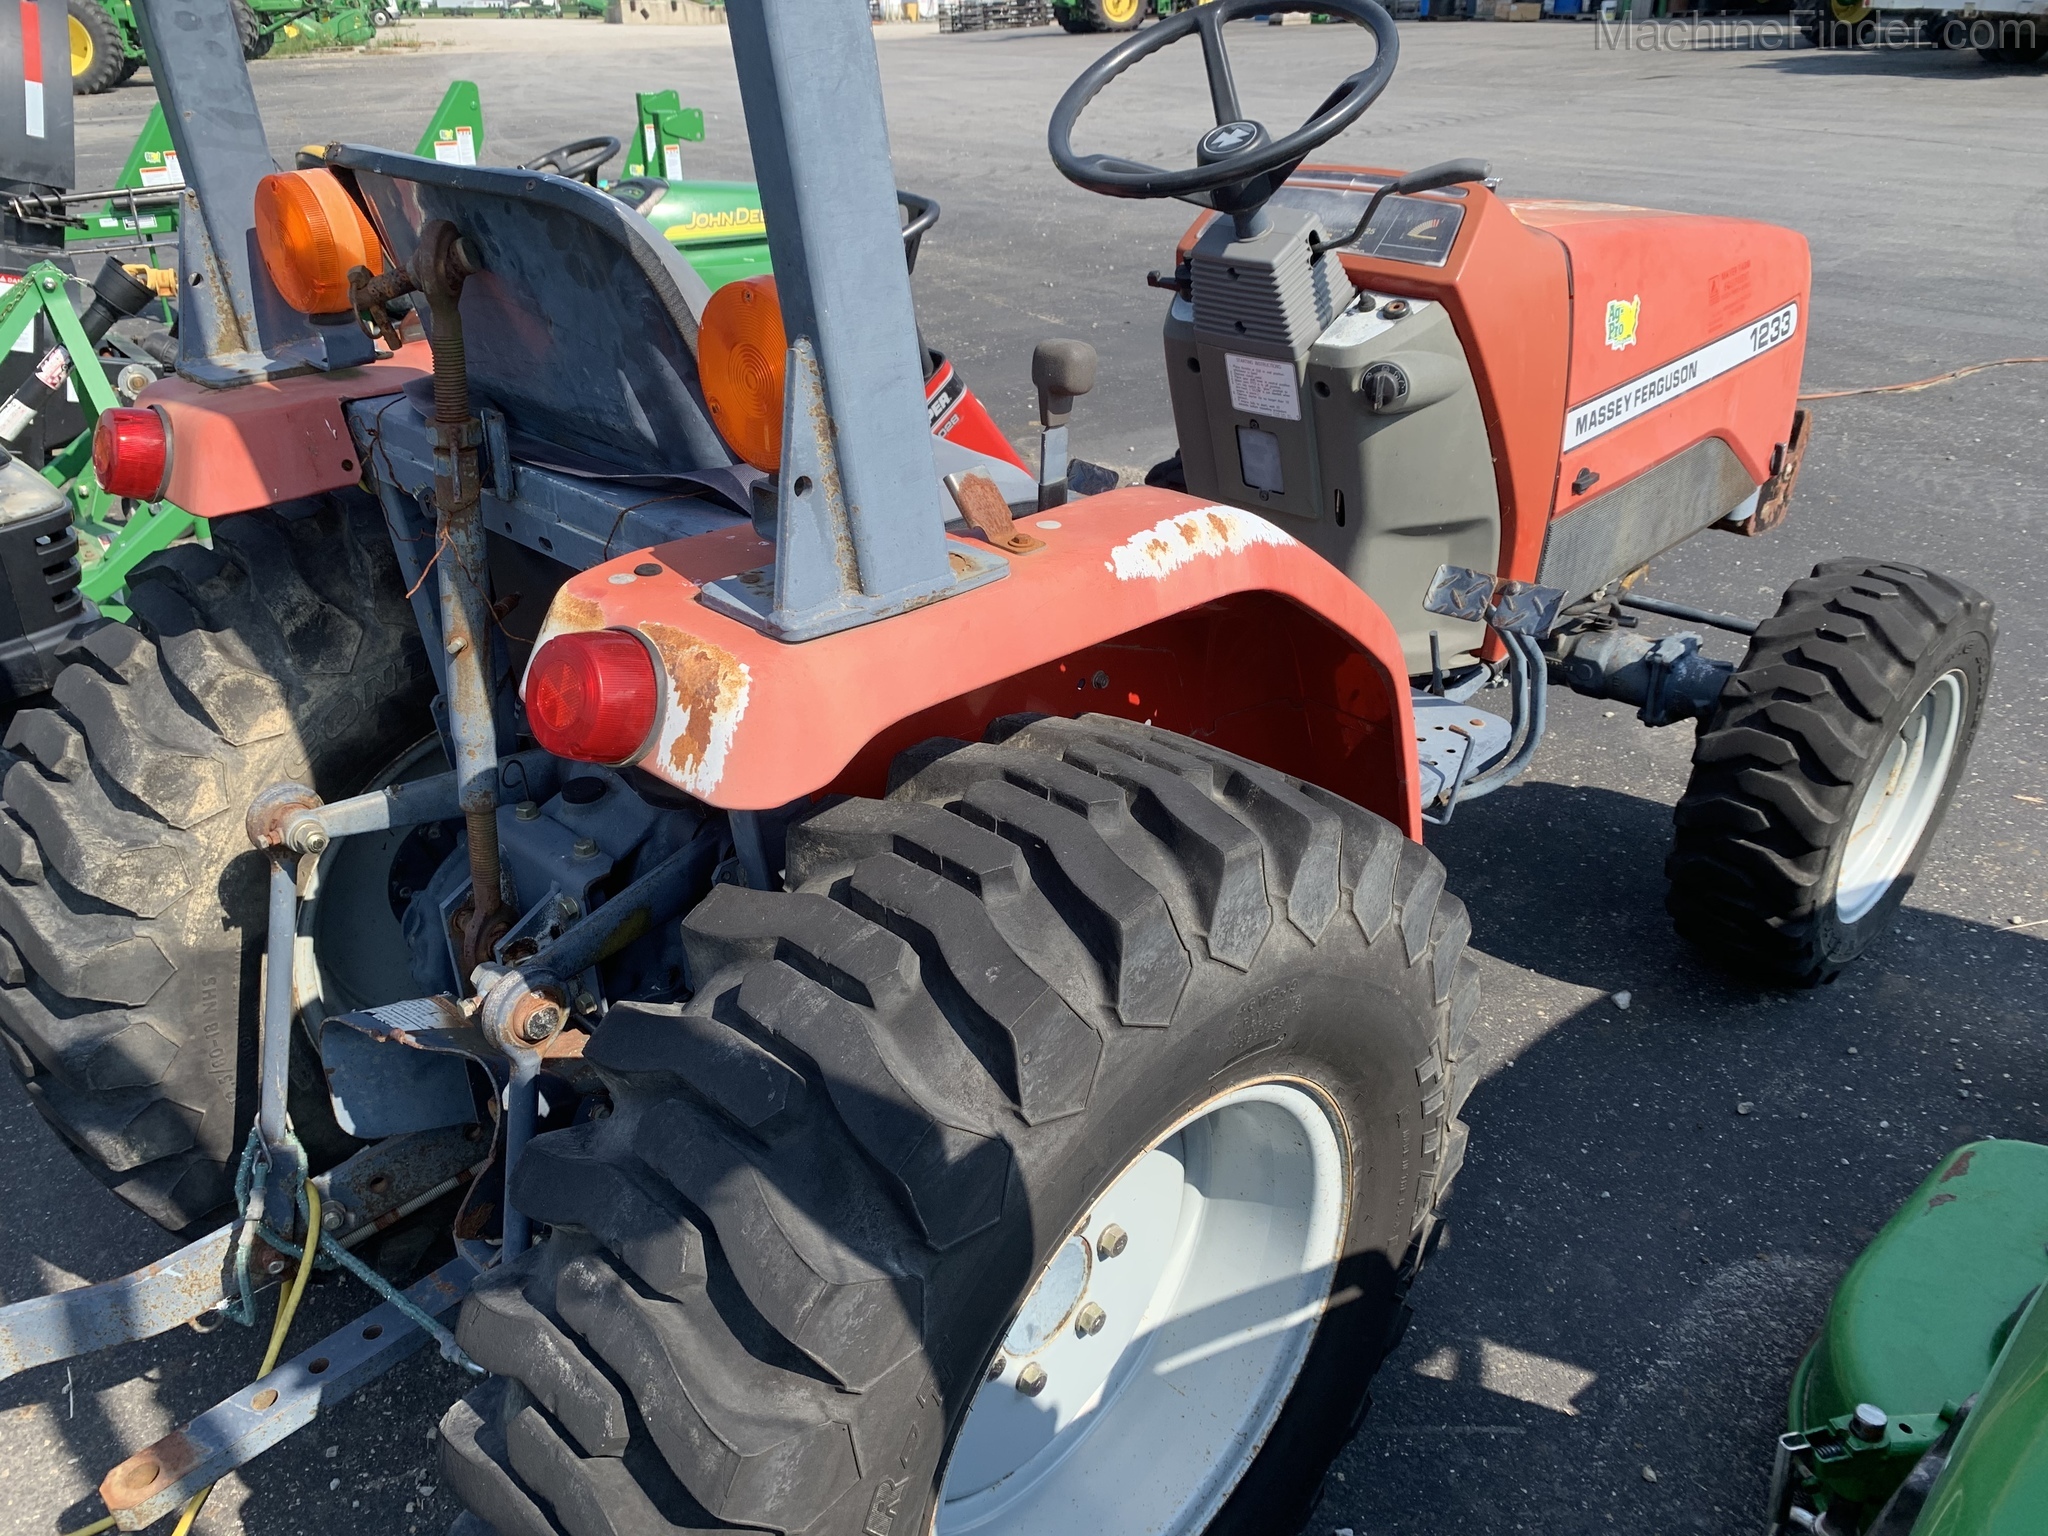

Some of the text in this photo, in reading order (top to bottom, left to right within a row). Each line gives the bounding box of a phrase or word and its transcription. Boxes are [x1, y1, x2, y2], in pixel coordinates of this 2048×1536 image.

[685, 201, 734, 230] JOHN
[1575, 392, 1633, 437] MASSEY
[1634, 360, 1698, 408] FERGUSON
[1750, 310, 1791, 352] 1233
[202, 976, 217, 1014] NHS
